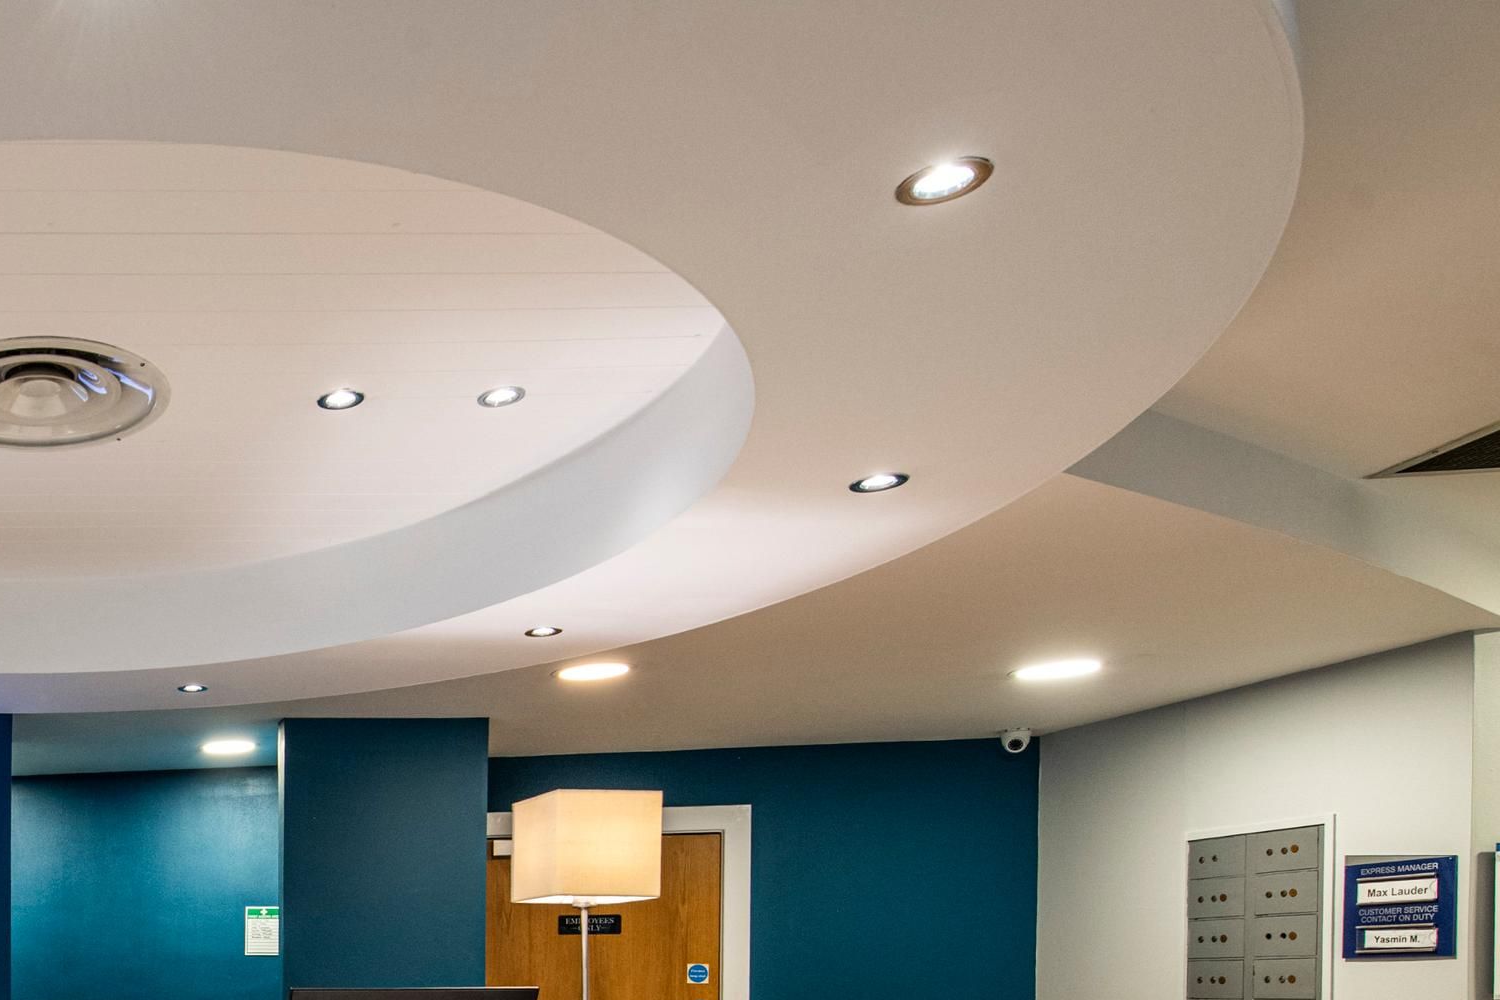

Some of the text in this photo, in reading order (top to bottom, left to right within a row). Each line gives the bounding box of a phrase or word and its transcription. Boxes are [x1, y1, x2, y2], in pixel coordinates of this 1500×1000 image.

[1360, 862, 1439, 875] EXPRESS MANAGER
[1367, 885, 1429, 898] Max Lauder
[1358, 905, 1439, 916] CUSTOMER SERVICE
[565, 917, 615, 925] EMOYEES
[1361, 915, 1397, 923] CONTACT
[1412, 913, 1435, 921] DUTY
[1374, 935, 1420, 944] Yasmin M.
